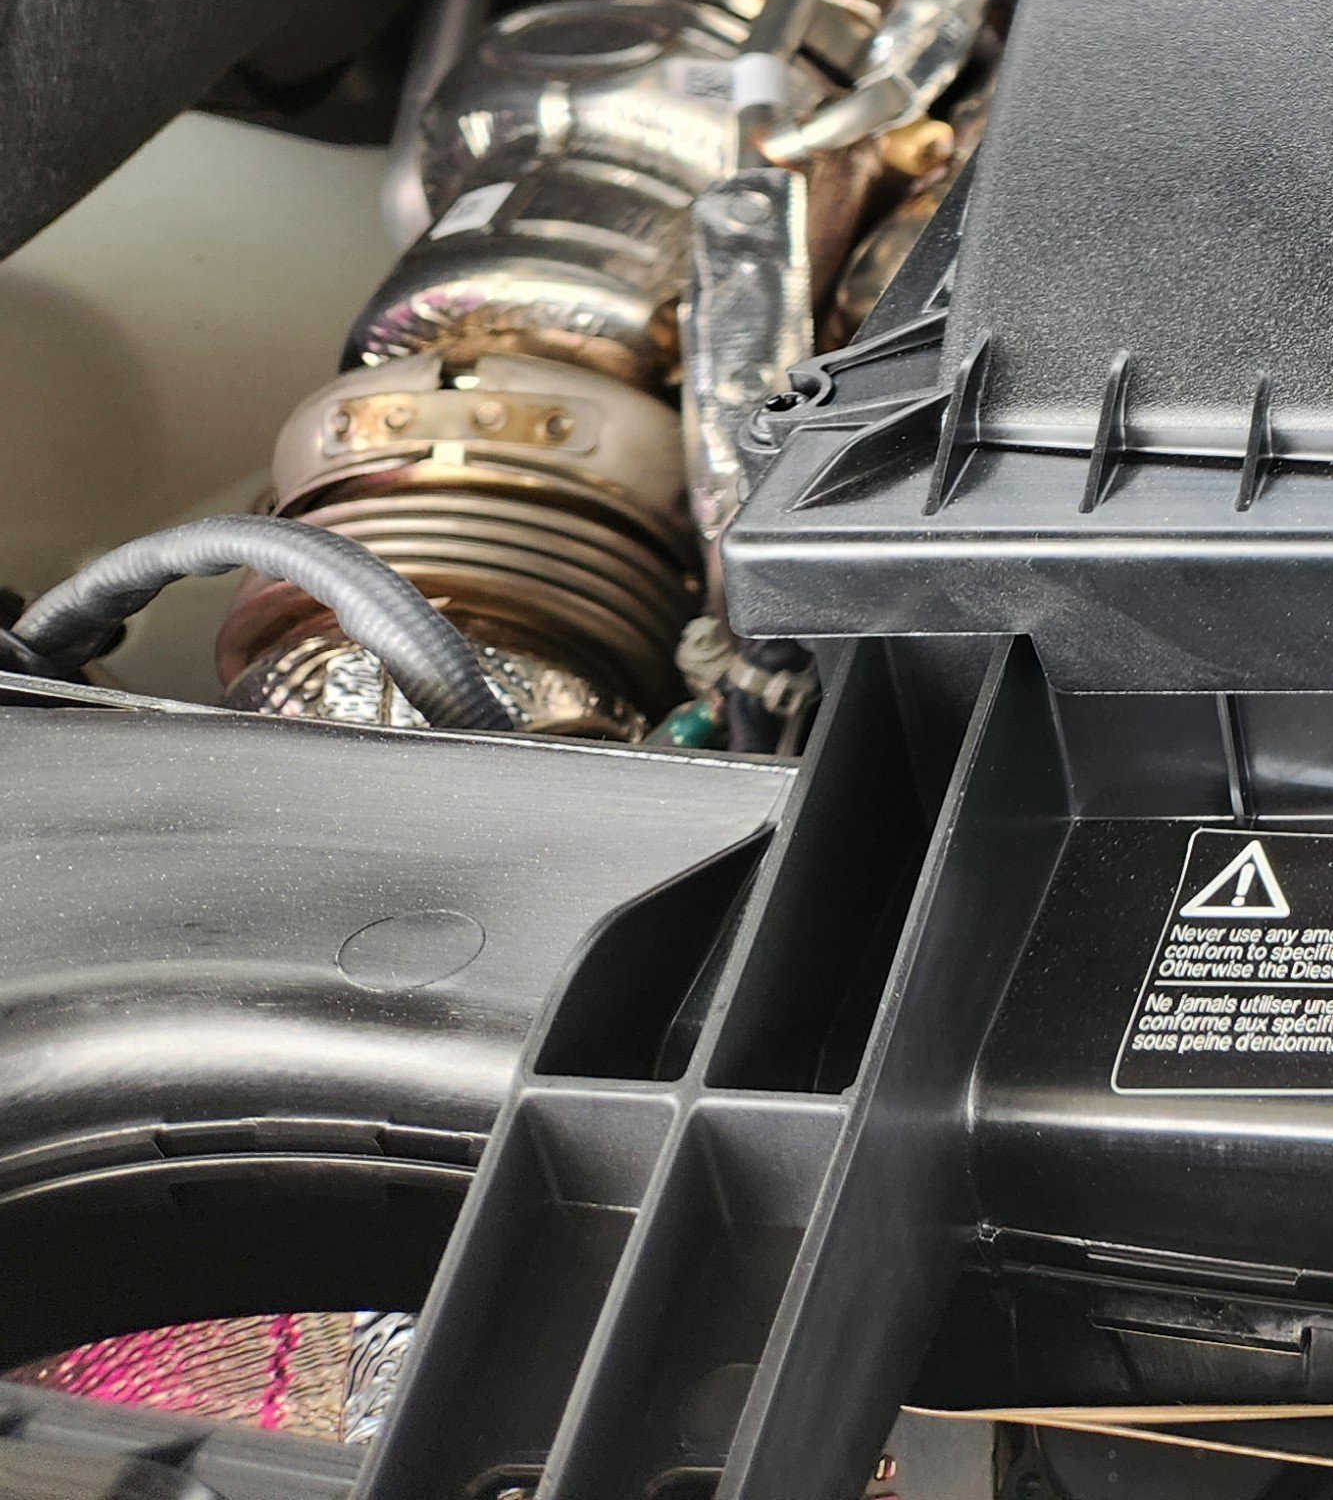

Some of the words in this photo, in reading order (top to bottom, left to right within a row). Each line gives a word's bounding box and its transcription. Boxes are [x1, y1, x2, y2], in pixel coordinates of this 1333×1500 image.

[1170, 924, 1227, 942] Never
[1229, 928, 1262, 943] use
[1265, 928, 1299, 946] any
[1164, 941, 1244, 960] conform
[1246, 943, 1267, 960] to
[1159, 959, 1254, 978] Otherwise
[1258, 961, 1288, 979] the
[1144, 993, 1173, 1012] Ne
[1174, 993, 1237, 1015] jamais
[1240, 994, 1302, 1014] utiliser
[1138, 1013, 1232, 1032] conforme
[1234, 1016, 1269, 1033] aux
[1132, 1033, 1178, 1050] sous
[1178, 1031, 1233, 1054] peine
